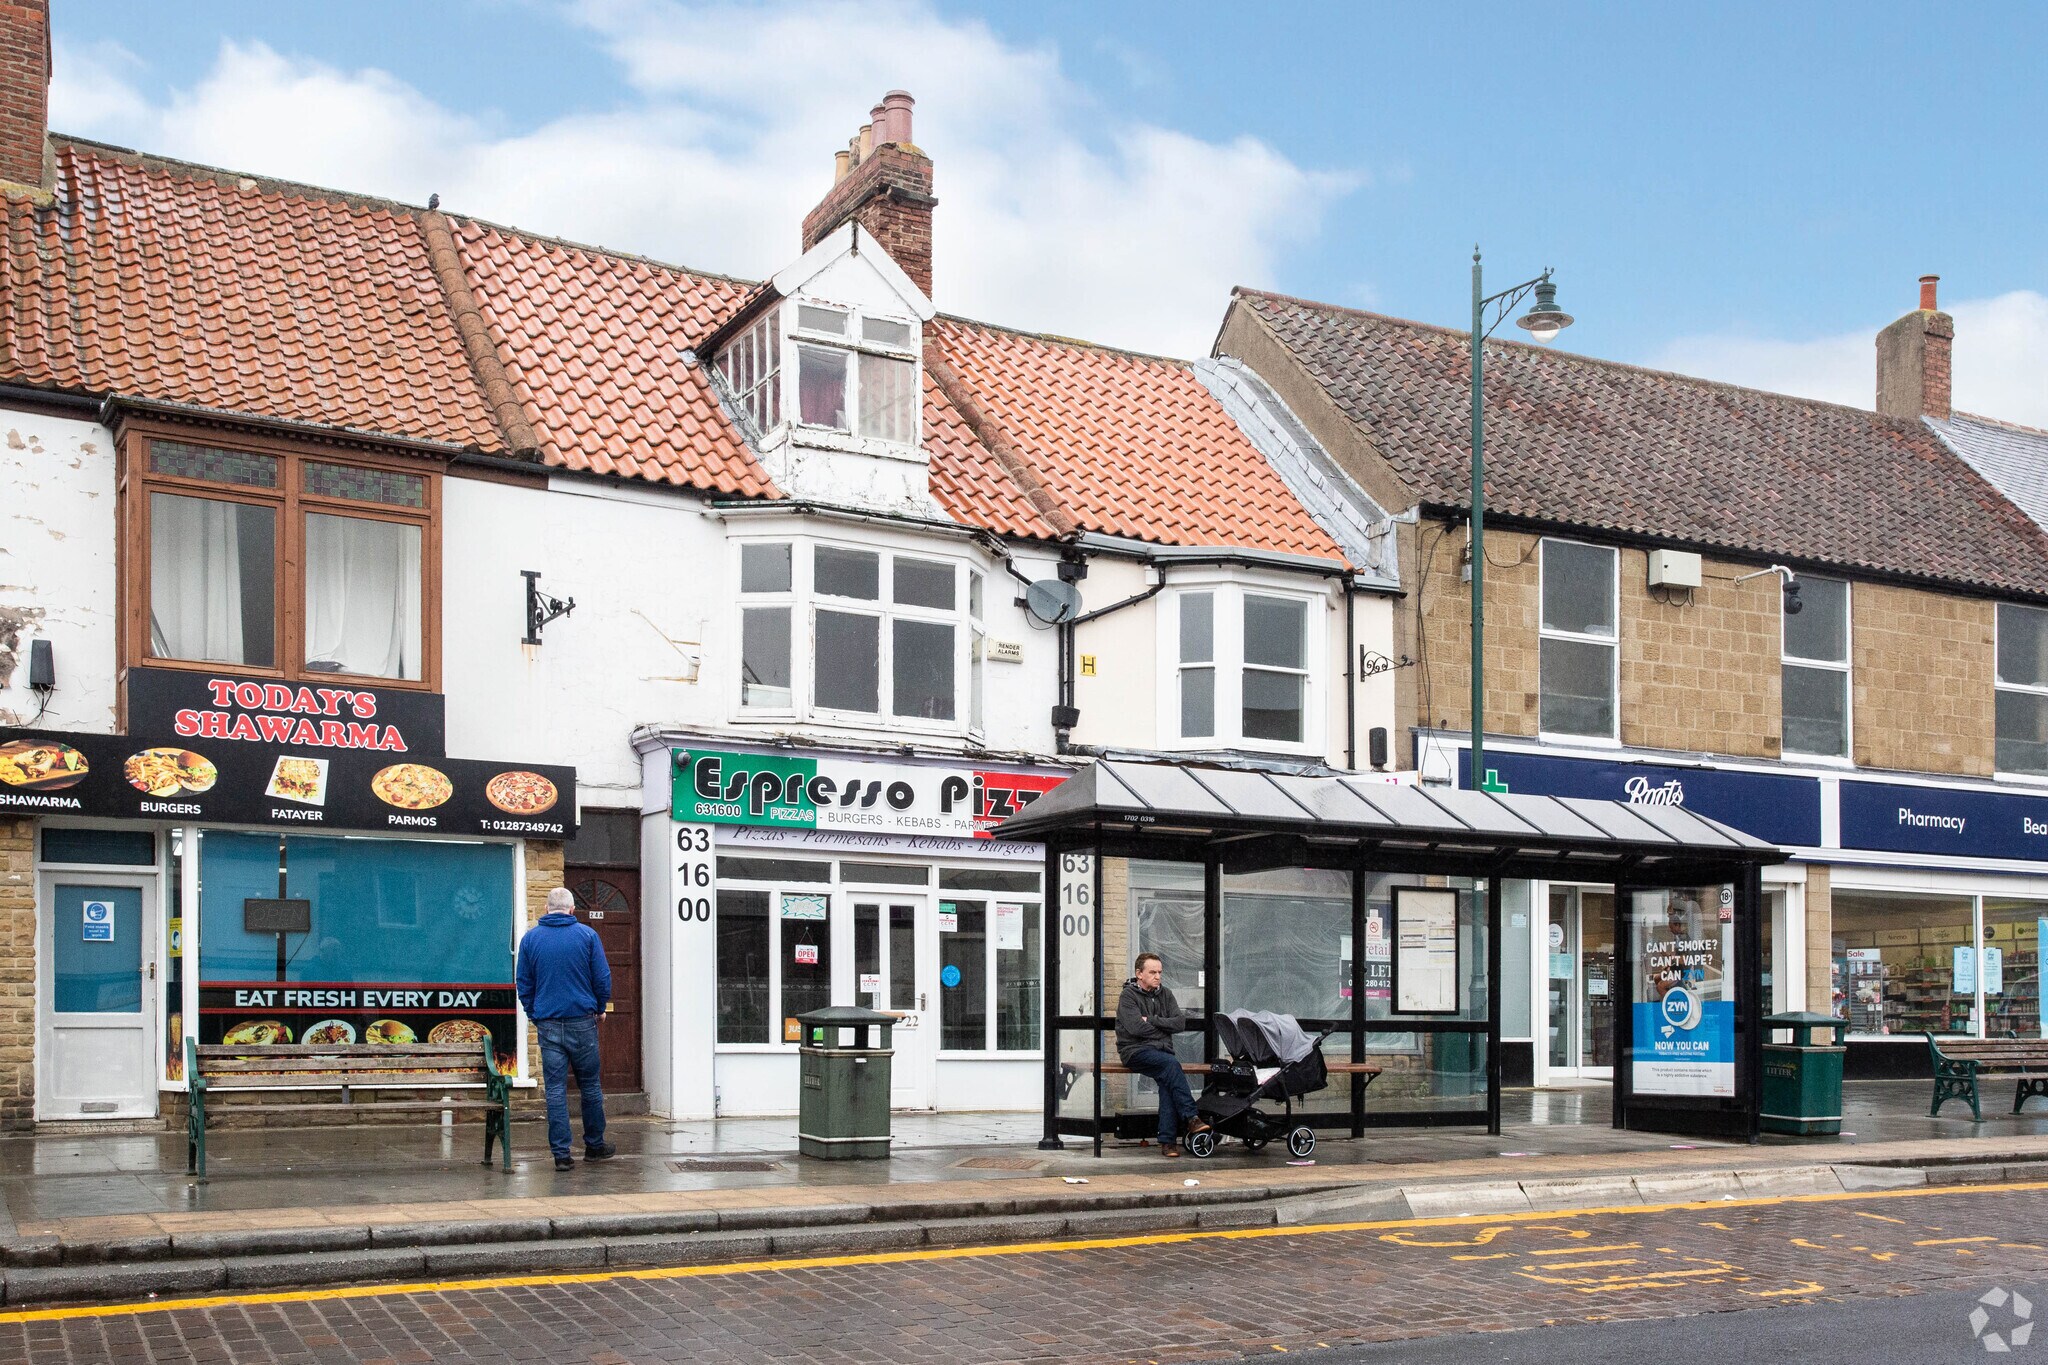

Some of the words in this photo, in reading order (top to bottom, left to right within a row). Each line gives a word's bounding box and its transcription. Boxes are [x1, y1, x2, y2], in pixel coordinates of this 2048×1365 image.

[998, 648, 1020, 657] ALARMS
[1083, 655, 1095, 674] H
[208, 679, 377, 719] TODAY'S
[174, 709, 409, 753] SHAWARMA
[694, 756, 915, 816] Espresso
[940, 775, 1043, 819] Pizz
[0, 793, 81, 810] SHAWARMA
[140, 801, 202, 815] BURGERS
[271, 808, 323, 823] FATAYER
[694, 803, 742, 818] 631600
[388, 814, 437, 827] PARMOS
[770, 806, 815, 822] PIZZAS
[828, 811, 884, 826] BURGERS
[896, 816, 942, 830] KEBABS
[954, 820, 1002, 832] PARMES
[1123, 814, 1139, 822] 1702
[1140, 815, 1156, 823] 0316
[1898, 807, 1967, 835] Pharmacy
[2023, 817, 2048, 836] Bea
[480, 819, 492, 830] T:
[493, 820, 564, 834] 01287349742
[677, 827, 710, 852] 63
[732, 826, 788, 842] Pizzas
[802, 830, 889, 848] Parmesans
[907, 834, 962, 852] Kebabs
[977, 840, 1038, 857] Burgers
[1062, 853, 1090, 874] 63
[677, 862, 710, 887] 16
[1062, 882, 1090, 906] 16
[678, 897, 710, 922] 00
[1062, 914, 1090, 937] 00
[1646, 941, 1676, 953] CAN'T
[1678, 939, 1719, 951] SMOKE?
[797, 950, 815, 958] OPEN
[1650, 956, 1681, 967] CAN'T
[1682, 954, 1714, 965] VAPE?
[1848, 950, 1865, 958] Sale
[1660, 970, 1682, 981] CAN
[1683, 968, 1705, 982] ZYN
[1365, 980, 1378, 988] 280
[235, 990, 278, 1007] EAT
[284, 990, 356, 1008] FRESH
[363, 991, 434, 1008] EVERY
[438, 991, 483, 1008] DAY
[1666, 1001, 1688, 1012] ZYN
[905, 1015, 919, 1027] 22
[1654, 1041, 1676, 1051] NOW
[1676, 1041, 1691, 1051] YOU
[1692, 1041, 1710, 1051] CAN
